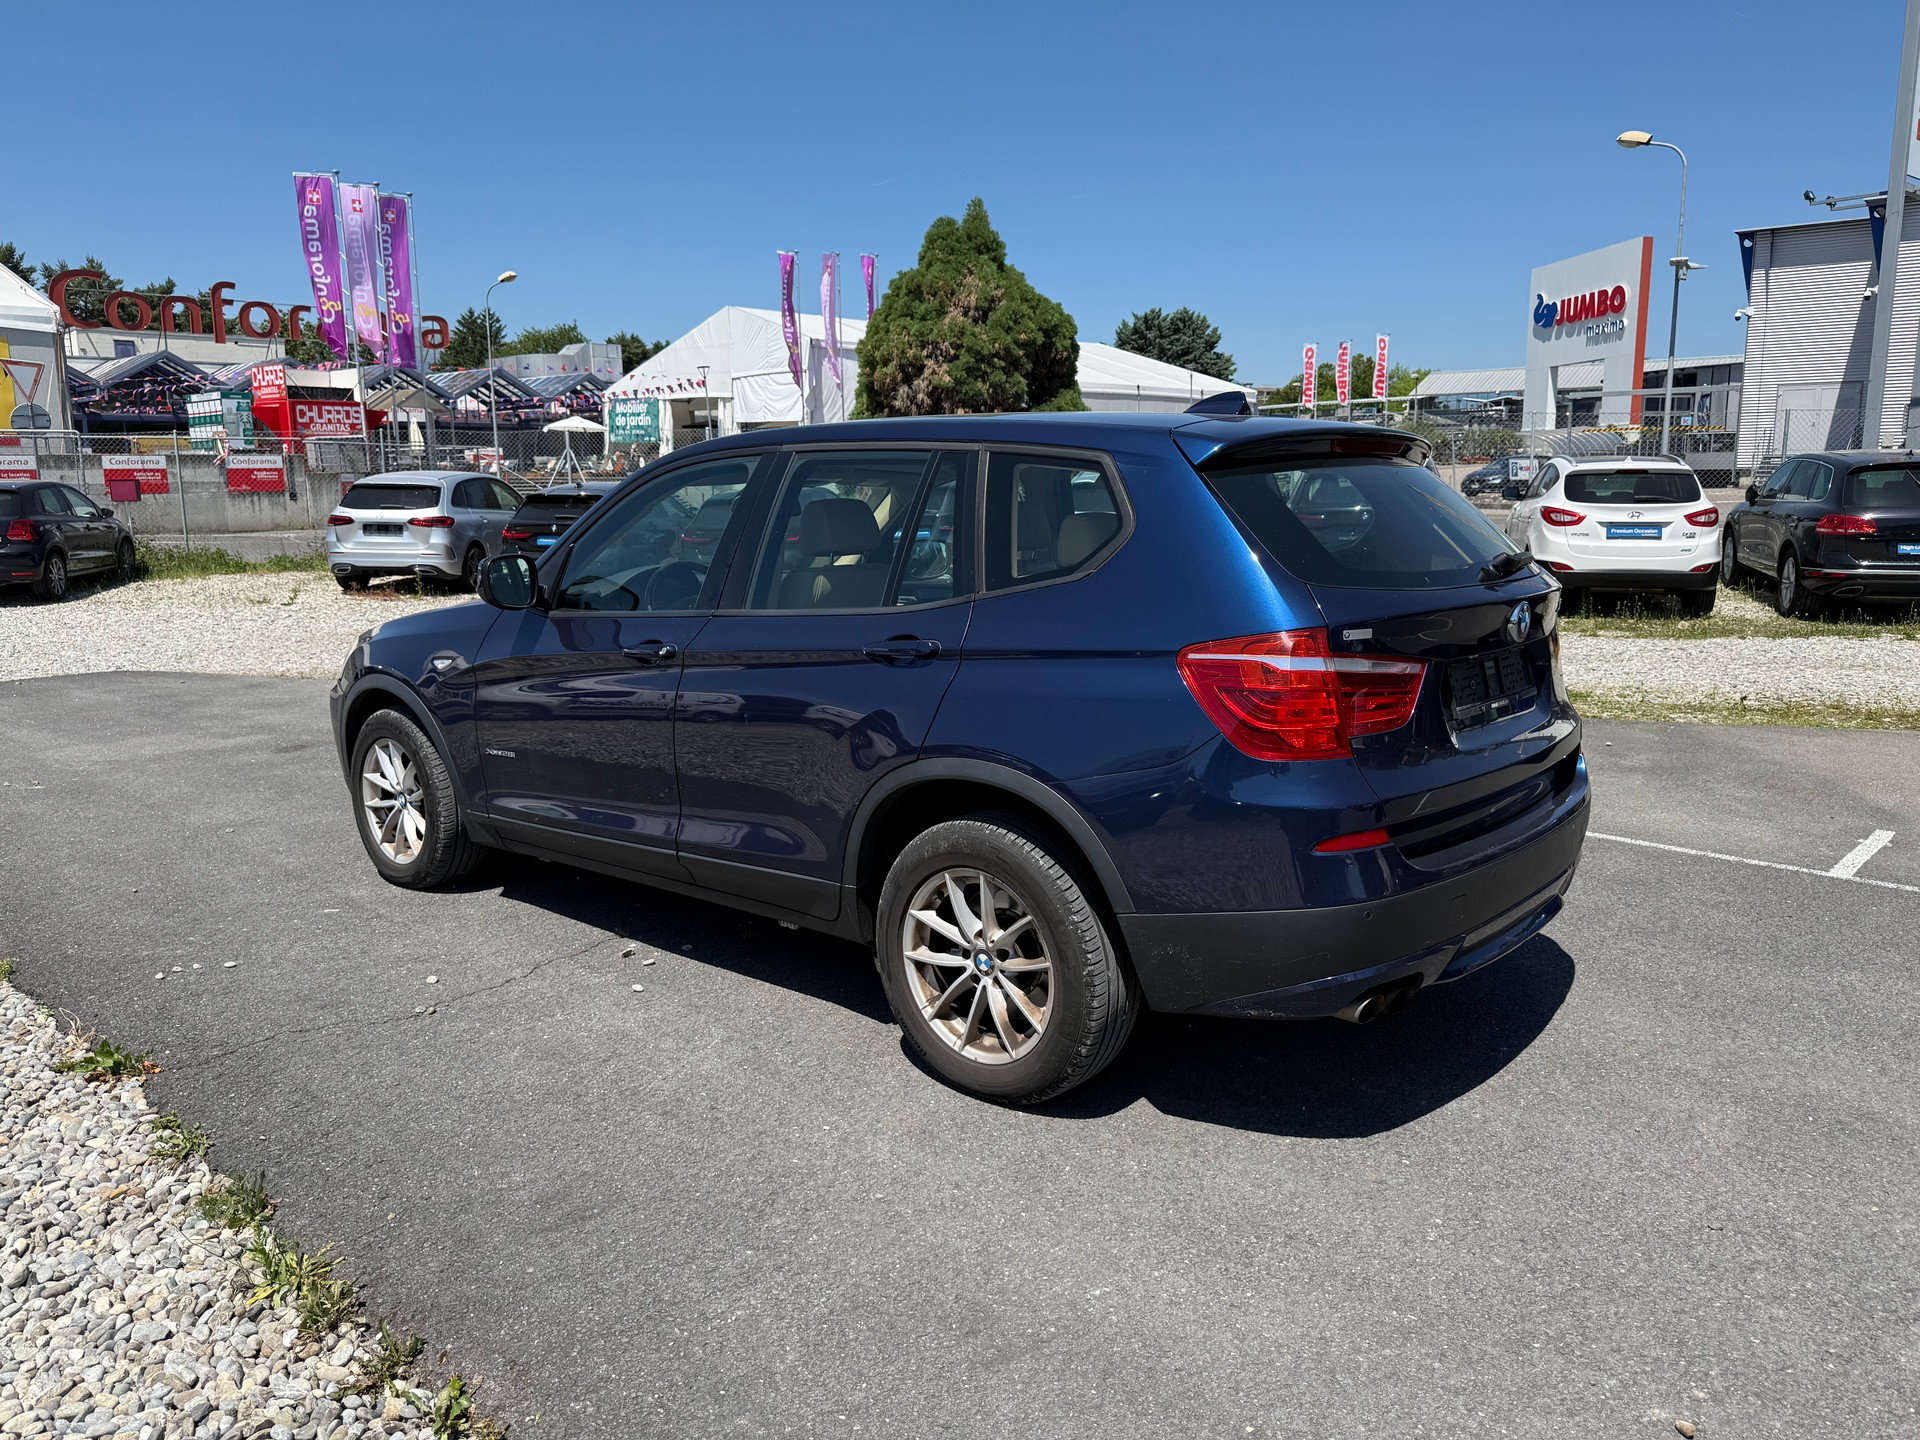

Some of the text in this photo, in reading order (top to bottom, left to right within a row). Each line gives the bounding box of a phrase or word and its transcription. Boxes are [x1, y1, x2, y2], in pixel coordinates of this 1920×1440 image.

[48, 269, 451, 349] Confora
[1555, 285, 1626, 326] JUMBO
[1586, 318, 1625, 336] maximo
[252, 365, 285, 387] CHURROS
[296, 404, 362, 424] CHURROS
[616, 400, 648, 413] Mobilier
[310, 423, 351, 432] GRANITAS
[616, 413, 651, 429] de jardin
[109, 457, 160, 466] Conforama
[231, 457, 278, 466] Conforama
